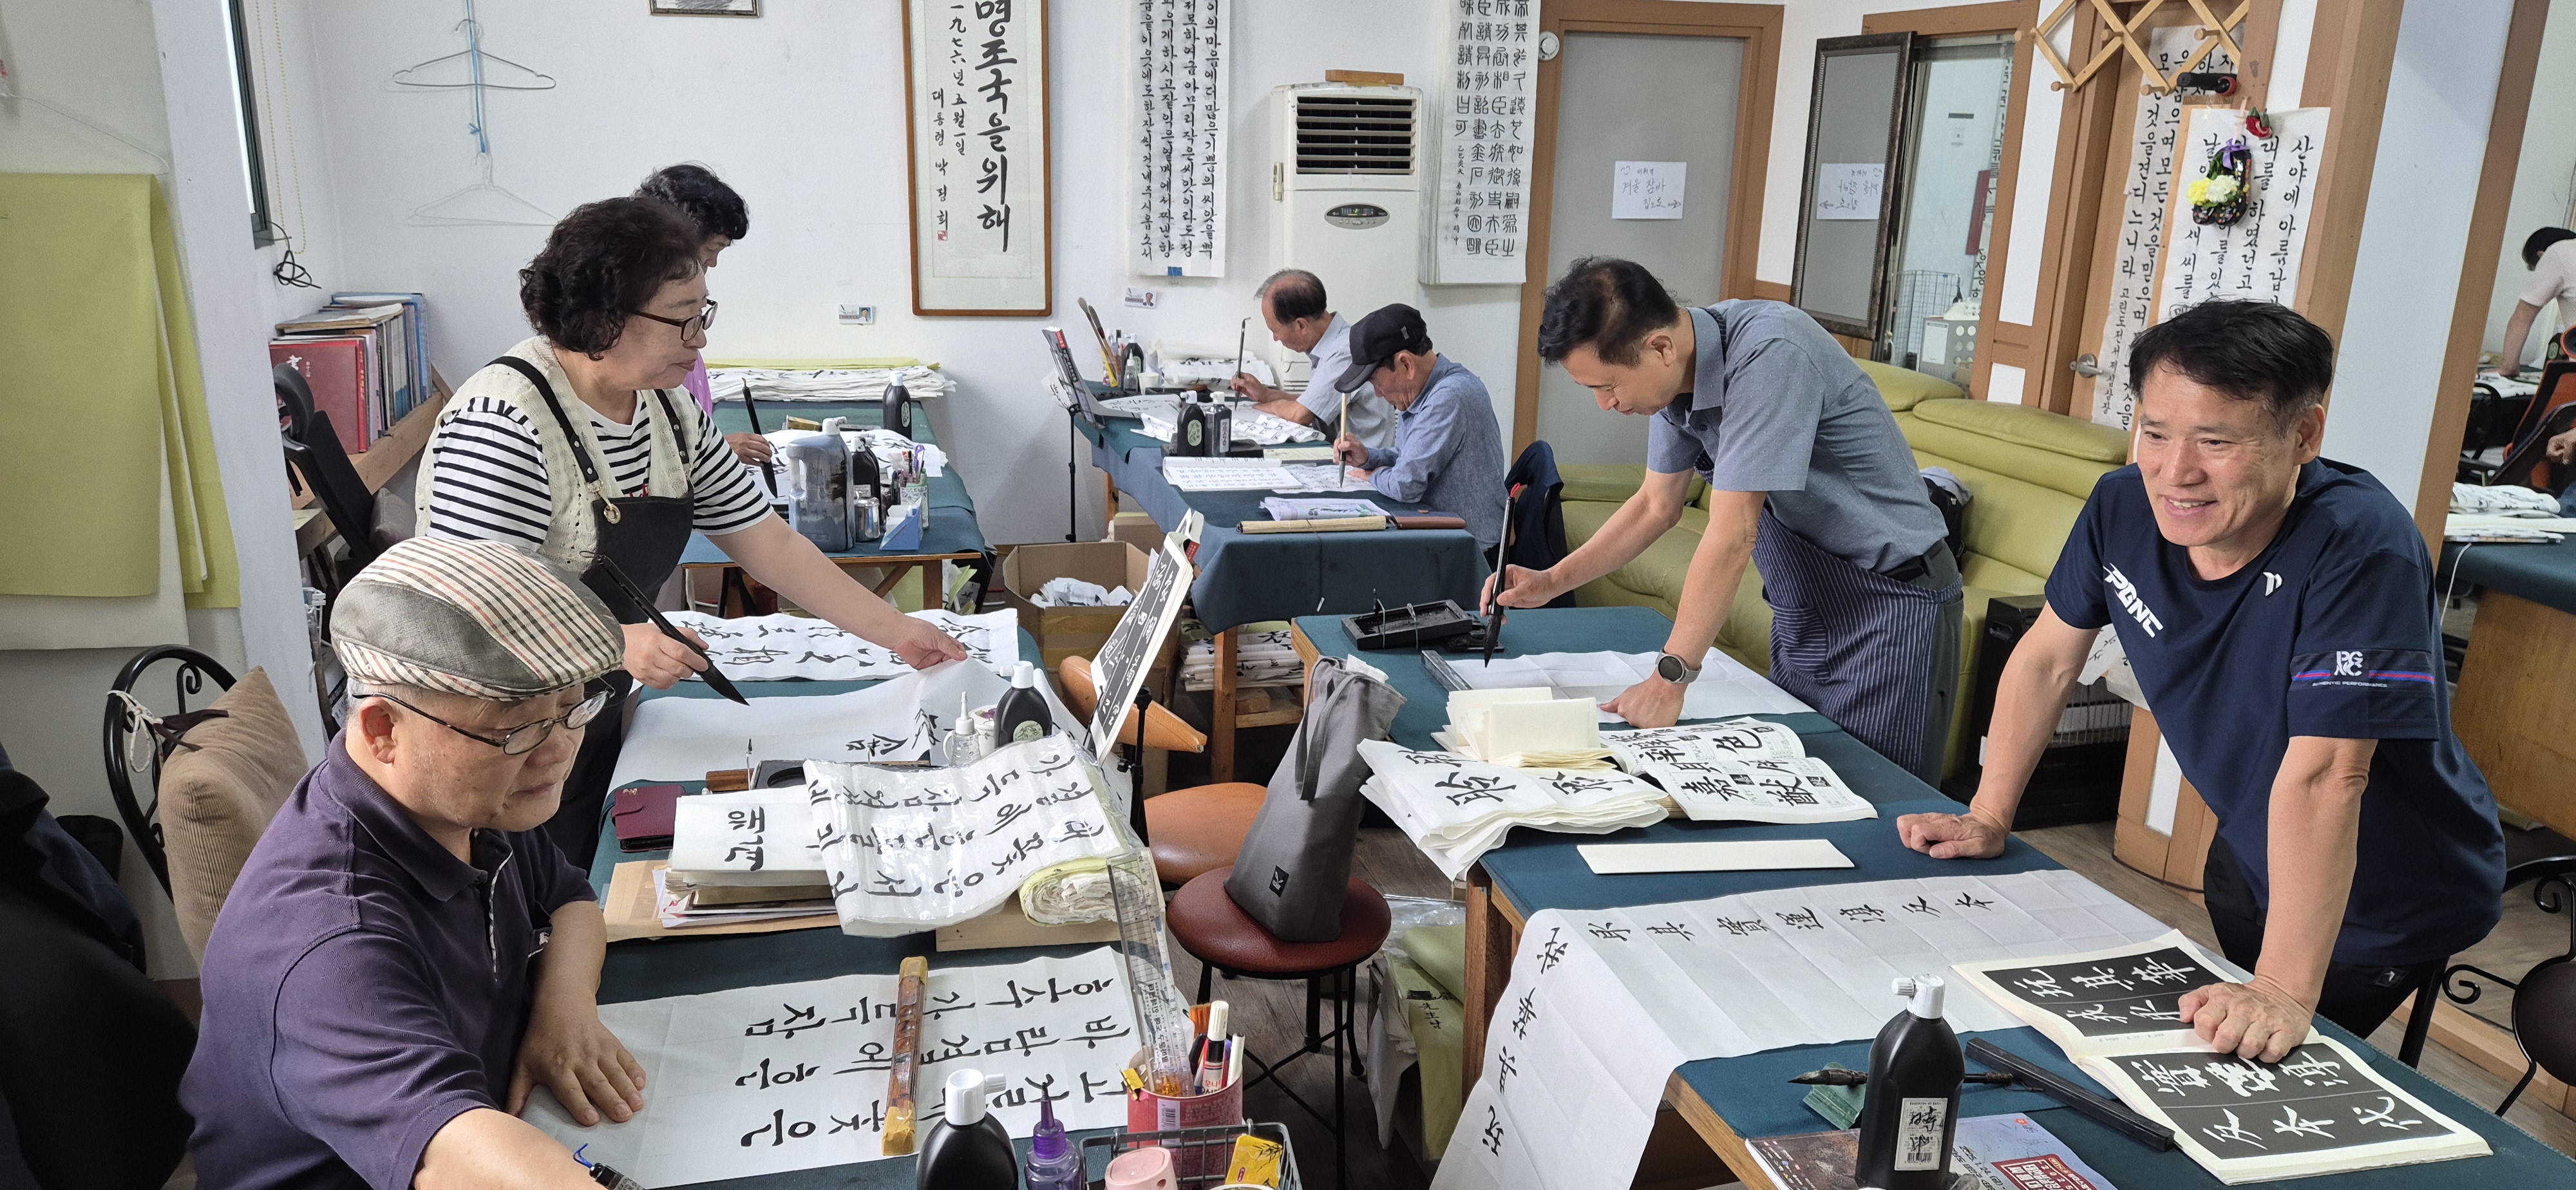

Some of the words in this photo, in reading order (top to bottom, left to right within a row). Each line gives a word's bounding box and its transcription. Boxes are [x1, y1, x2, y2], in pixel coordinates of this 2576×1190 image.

[932, 88, 945, 147] 대통령
[1622, 178, 1641, 196] 겨울
[1646, 177, 1667, 194] 잠바
